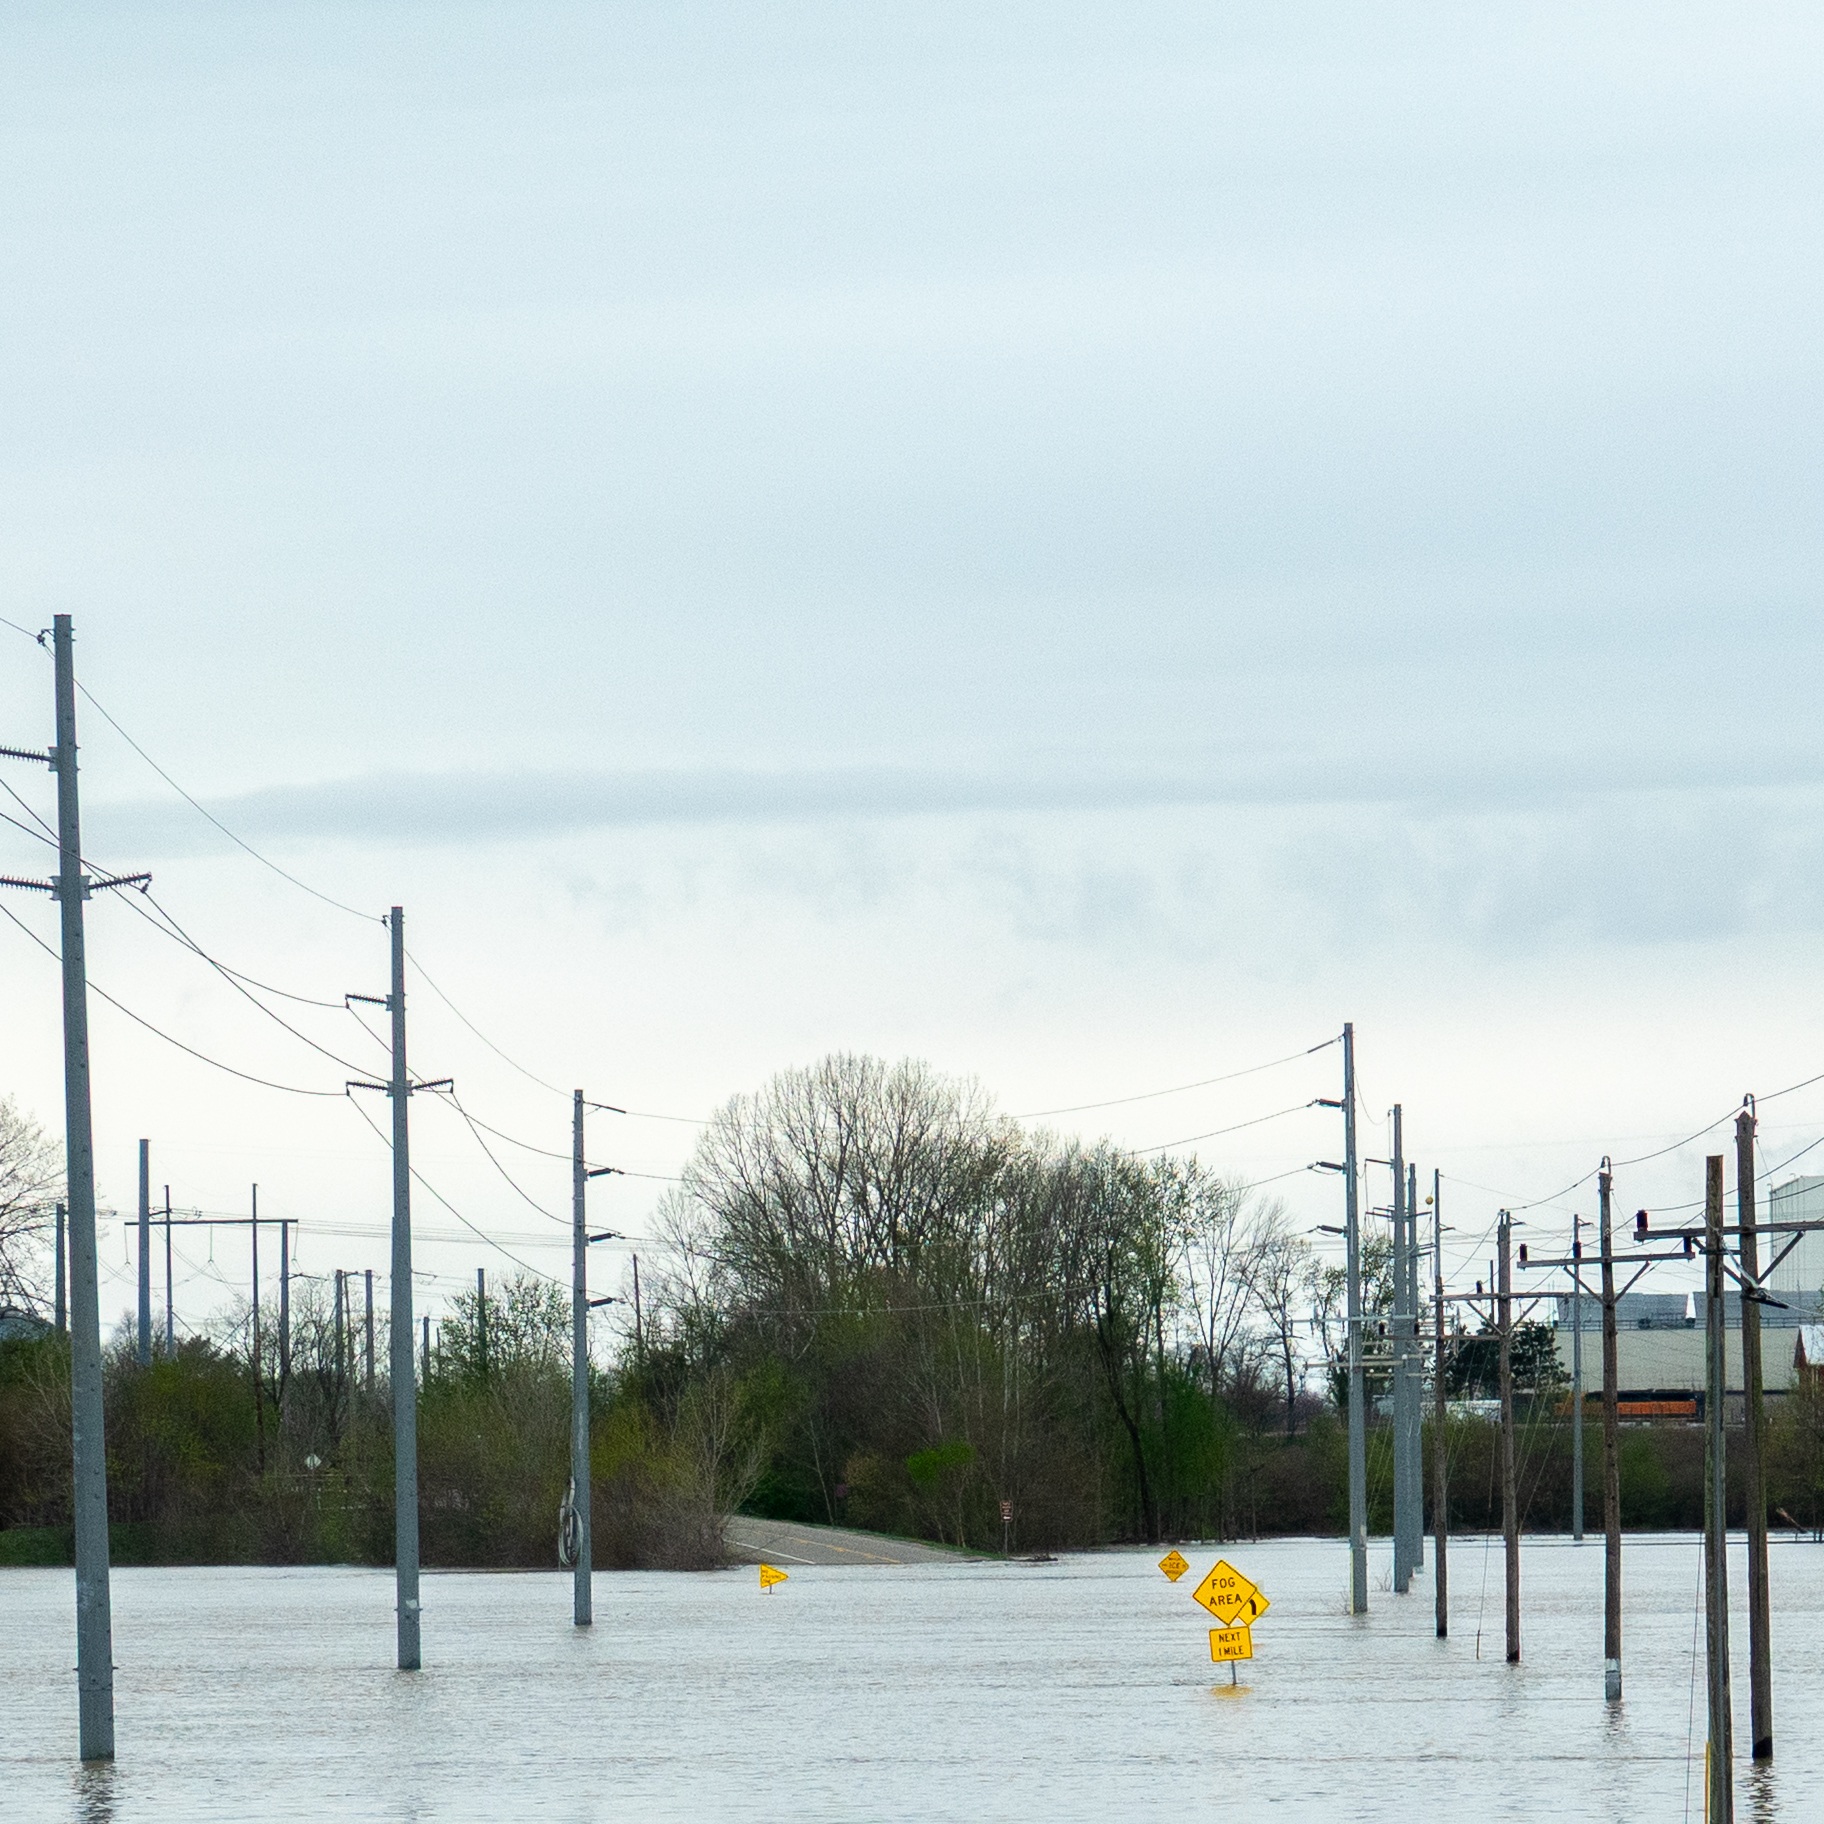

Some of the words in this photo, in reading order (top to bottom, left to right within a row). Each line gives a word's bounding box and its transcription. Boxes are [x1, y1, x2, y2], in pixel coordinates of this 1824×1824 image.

[1211, 1577, 1235, 1589] FOG
[1209, 1594, 1242, 1606] AREA
[1218, 1632, 1240, 1643] NEXT
[1218, 1647, 1222, 1657] 1
[1223, 1645, 1244, 1655] MILE
